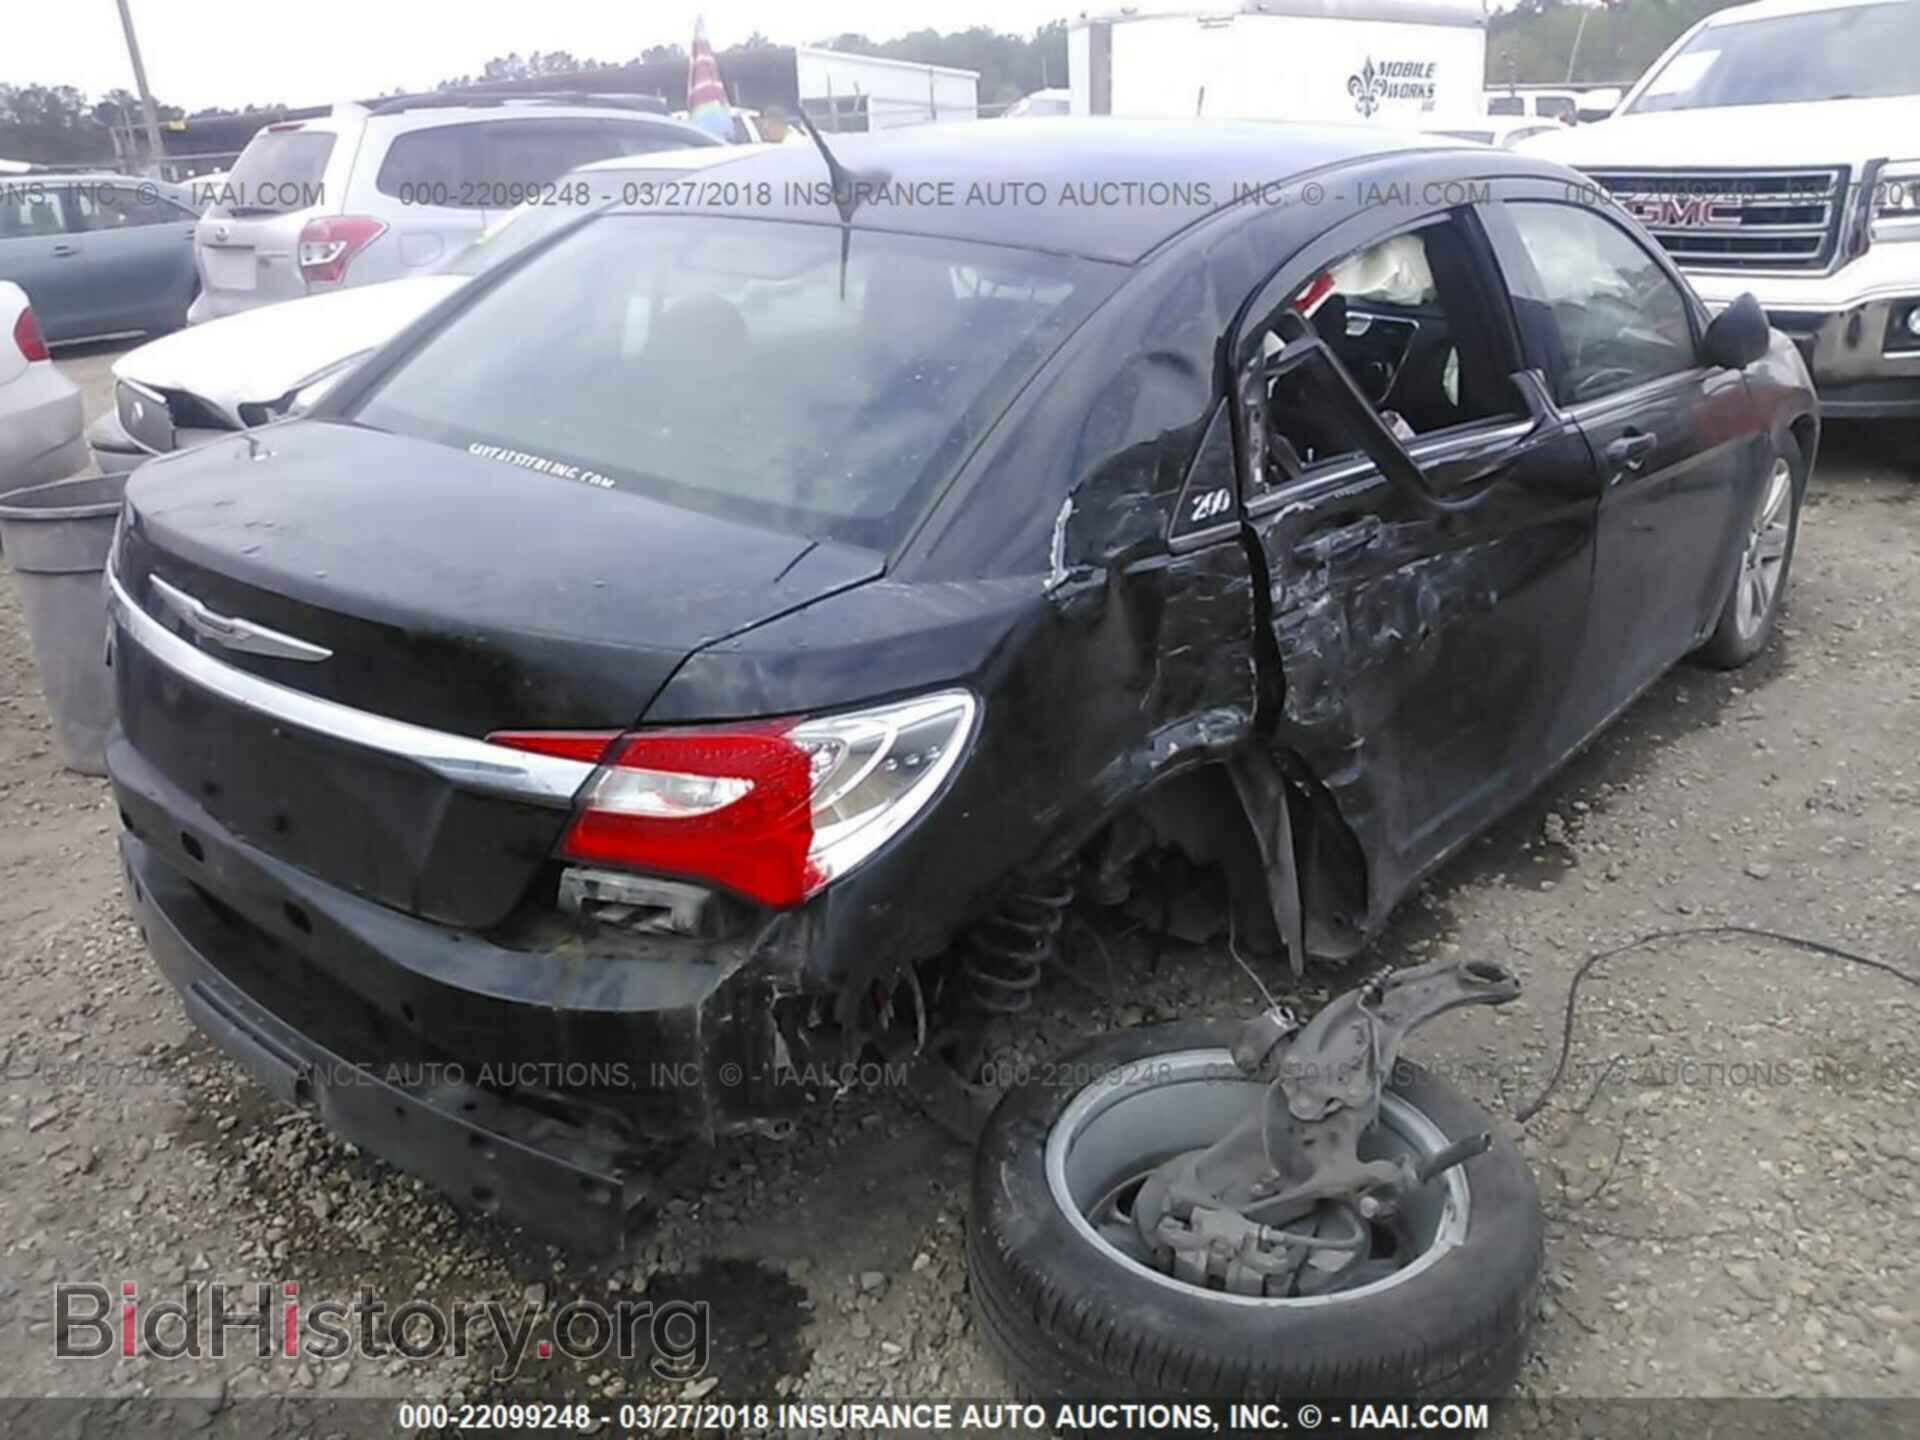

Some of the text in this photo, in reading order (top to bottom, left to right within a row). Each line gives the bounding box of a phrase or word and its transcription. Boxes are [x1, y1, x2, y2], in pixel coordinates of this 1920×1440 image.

[1379, 61, 1437, 78] MOBILE
[1387, 82, 1436, 98] WORKS
[1624, 199, 1743, 226] GMC
[1191, 488, 1230, 521] 200
